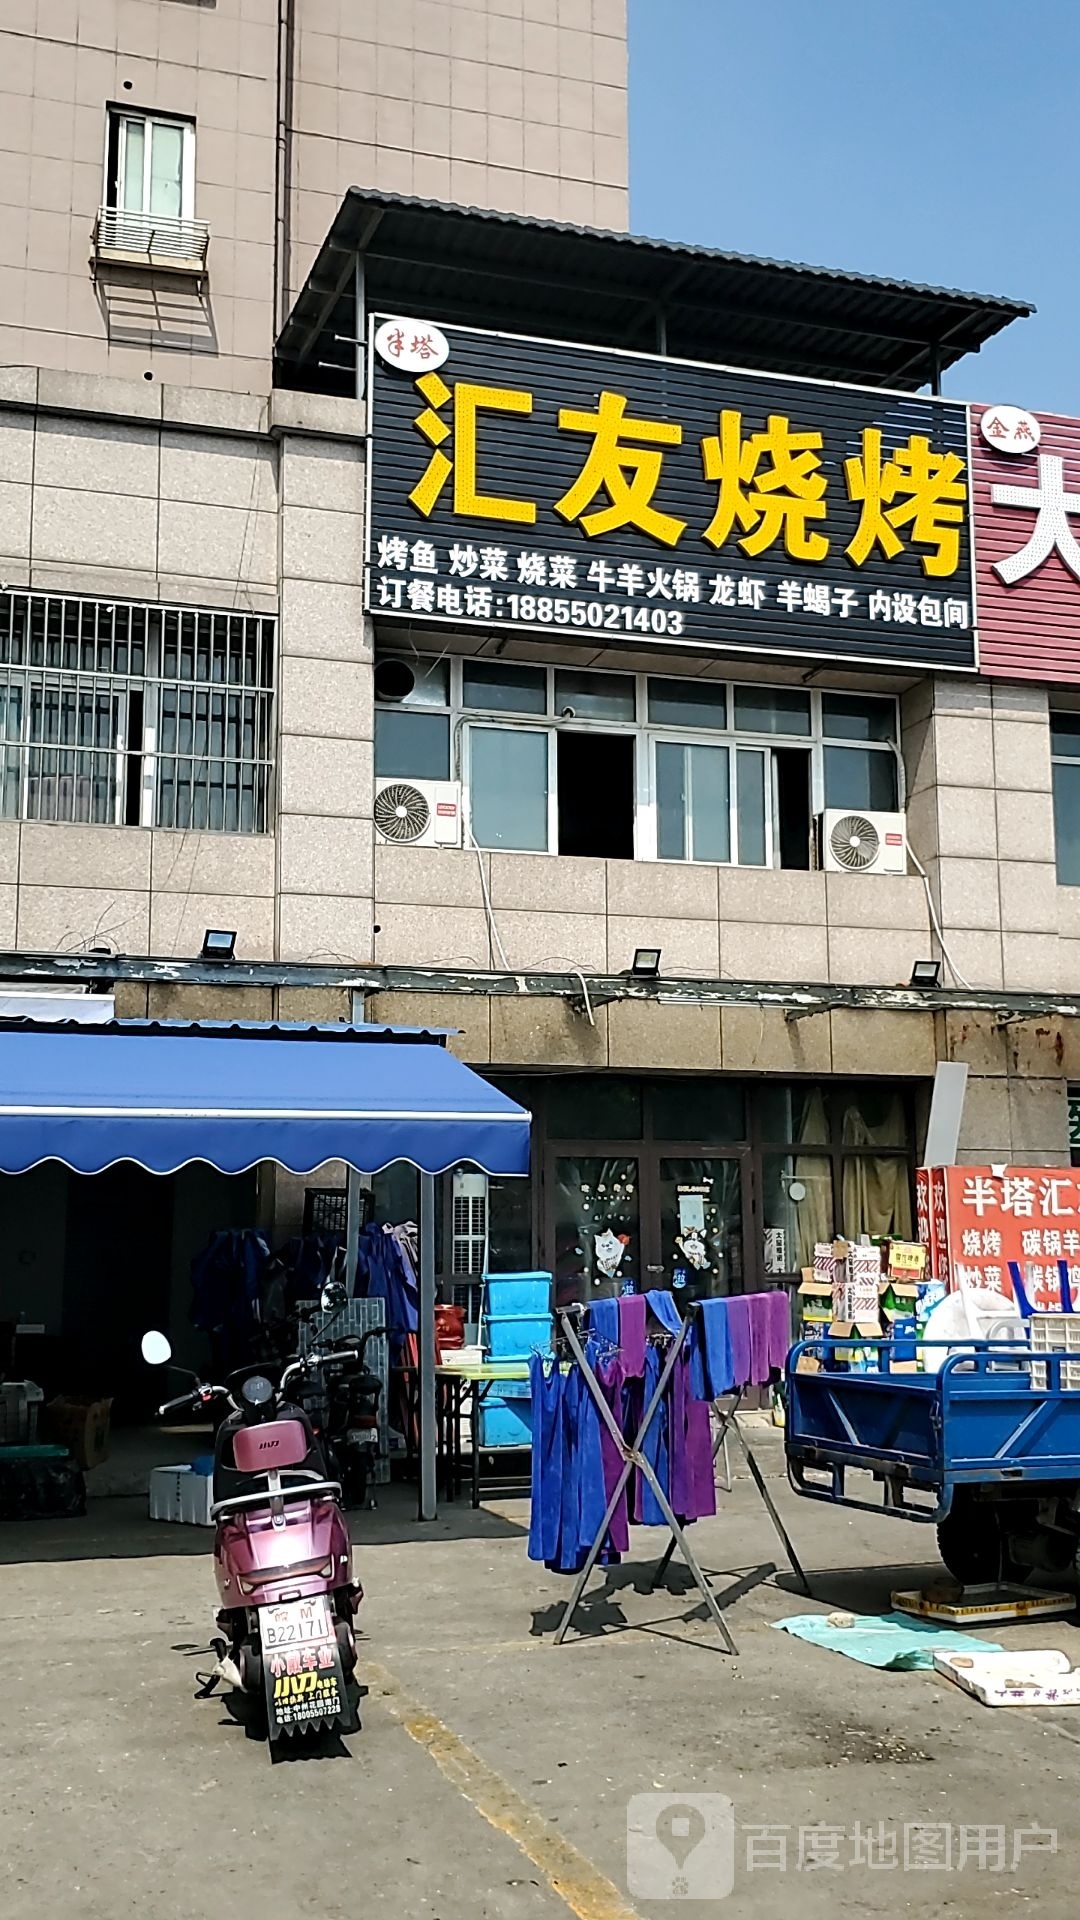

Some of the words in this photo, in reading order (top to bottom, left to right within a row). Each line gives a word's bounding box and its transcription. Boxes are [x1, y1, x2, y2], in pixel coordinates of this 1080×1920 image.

[386, 328, 439, 359] 半塔
[986, 416, 1036, 443] 金燕
[408, 371, 967, 578] 汇友烧烤
[991, 453, 1080, 585] 大
[377, 535, 439, 574] 烤鱼
[448, 543, 509, 581] 炒菜
[516, 551, 578, 589] 烧菜
[586, 559, 702, 603] 牛羊火锅
[708, 573, 766, 611] 龙虾
[776, 580, 860, 619] 羊蝎子
[868, 589, 969, 630] 内设包间
[377, 575, 684, 636] 订餐电话:18855021403
[962, 1175, 1080, 1217] 半塔汇
[962, 1229, 1002, 1257] 烧烤
[267, 1619, 323, 1643] B22171
